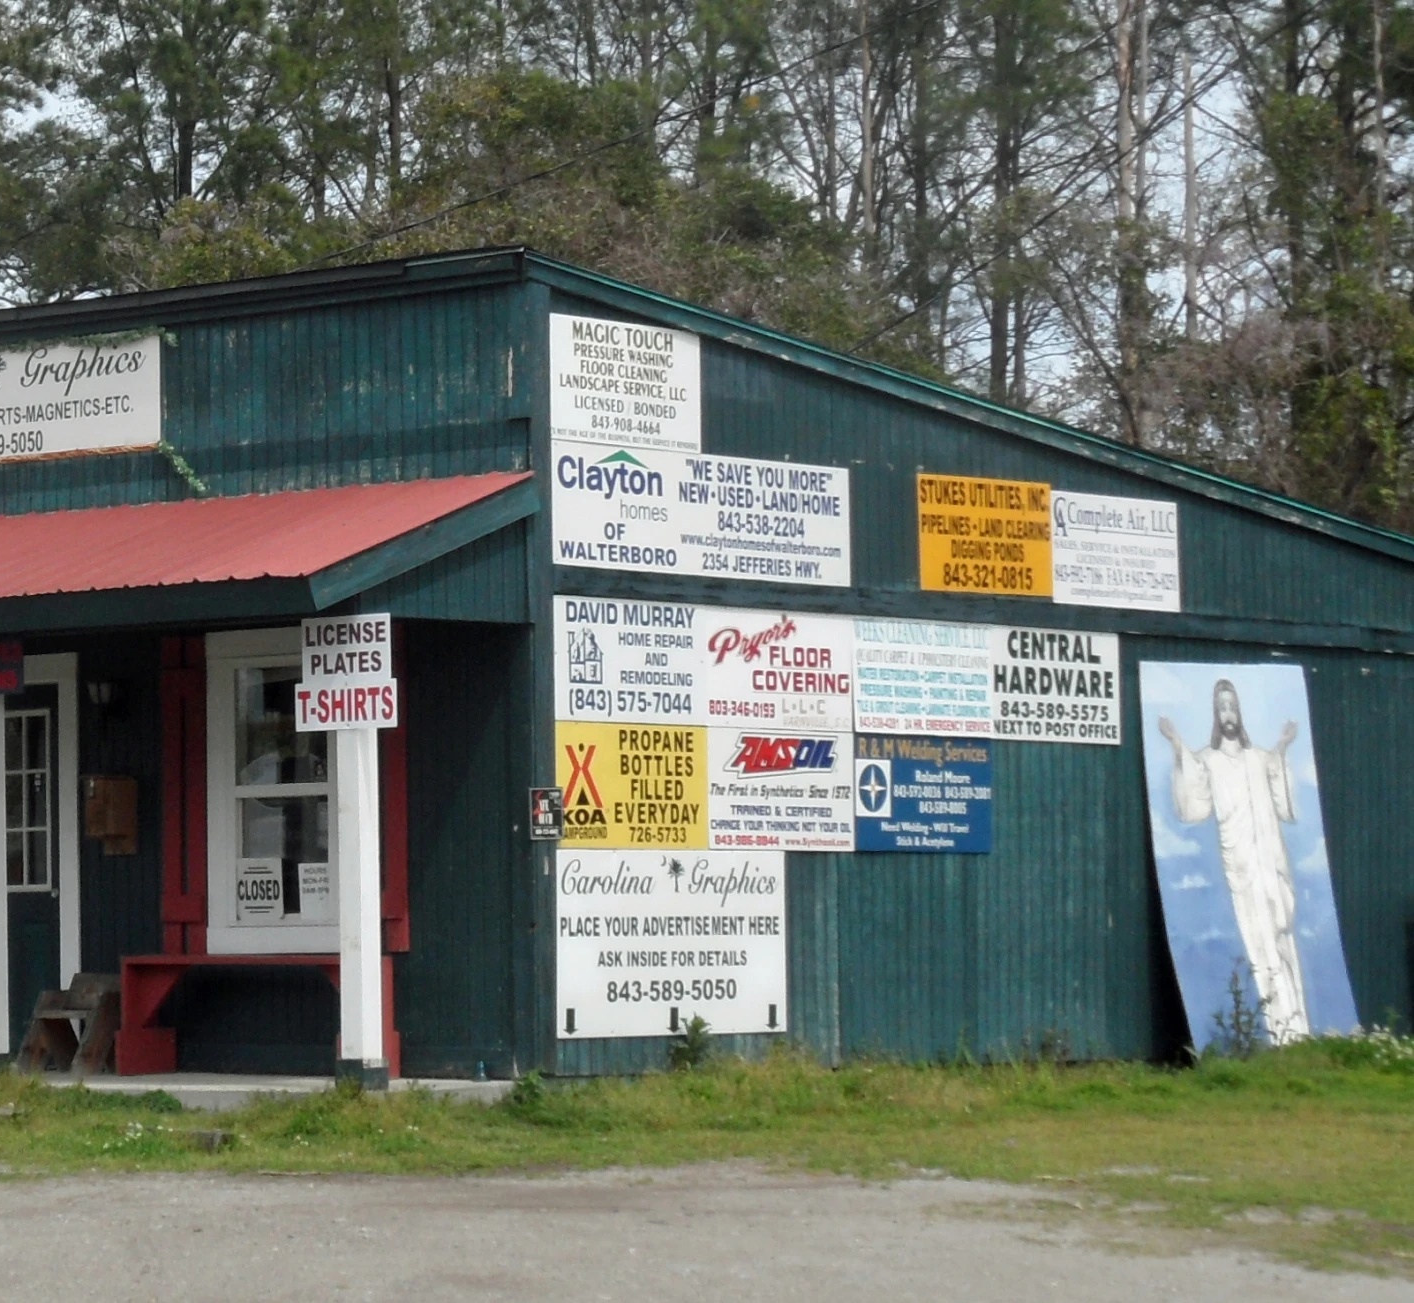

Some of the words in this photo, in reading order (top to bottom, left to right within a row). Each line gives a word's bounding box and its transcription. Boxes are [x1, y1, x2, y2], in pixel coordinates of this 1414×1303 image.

[572, 321, 620, 345] MAGIC
[625, 328, 673, 352] TOUCH
[574, 343, 625, 362] PRESSURE
[628, 349, 673, 368] WASHING
[20, 347, 146, 396] Graphics
[580, 360, 614, 376] FLOOR
[618, 365, 667, 383] CLEANING
[560, 374, 619, 394] LANDSCAPE
[623, 381, 666, 400] SERVICE,
[669, 386, 687, 401] LLC
[574, 395, 624, 413] LICENSED
[634, 402, 676, 419] BONDED
[592, 415, 660, 435] 843-908-4664
[557, 455, 663, 500] Clayton
[717, 462, 752, 486] SAVE
[756, 466, 784, 489] YOU
[920, 479, 966, 506] STUKES
[969, 483, 1025, 515] UTILITIES,
[1027, 487, 1049, 512] INC.
[619, 500, 668, 522] homes
[1068, 502, 1123, 533] Complete
[1127, 509, 1148, 532] Air,
[1151, 510, 1174, 533] LLC
[604, 522, 626, 540] OF
[717, 511, 805, 538] 843-538-2204
[921, 514, 970, 536] PIPELINES
[979, 518, 1003, 538] LAND
[1006, 520, 1050, 541] CLEARING
[559, 540, 677, 567] WALTERBORO
[680, 532, 841, 558] www.claytonhomesofwalterboro.com
[951, 539, 991, 560] DIGGING
[994, 542, 1024, 563] PONDS
[1081, 541, 1111, 553] SERVICE
[702, 552, 729, 572] 2354
[732, 555, 792, 578] JEFFERIES
[795, 559, 822, 579] HWY.
[943, 563, 1033, 590] 843-321-0815
[566, 601, 618, 625] DAVID
[623, 604, 695, 629] MURRAY
[306, 621, 386, 647] LICENSE
[618, 632, 651, 647] HOME
[654, 634, 693, 649] REPAIR
[708, 614, 796, 666] Pryor's
[886, 622, 932, 646] CLEANING
[934, 624, 971, 648] SERVICE
[769, 645, 832, 668] FLOOR
[1007, 630, 1101, 664] CENTRAL
[311, 651, 382, 675] PLATES
[645, 652, 668, 666] AND
[884, 650, 908, 664] CARPET
[958, 655, 988, 669] CLEANING
[620, 670, 693, 687] REMODELING
[752, 670, 850, 694] COVERING
[994, 664, 1114, 699] HARDWARE
[860, 683, 893, 697] PRESSURE
[894, 685, 923, 699] WASHING
[297, 686, 394, 724] T-SHIRTS
[569, 688, 612, 718] (843)
[617, 690, 692, 715] 575-7044
[709, 699, 775, 719] 803-346-0193
[1001, 700, 1109, 722] 843-589-5575
[926, 719, 963, 731] EMERGENCY
[965, 721, 990, 732] SERVICE
[994, 720, 1023, 735] NEXT
[1026, 721, 1041, 735] TO
[1045, 722, 1075, 737] POST
[1079, 723, 1117, 739] OFFICE
[619, 730, 694, 752] PROPANE
[858, 737, 867, 757] R
[871, 738, 880, 758] &
[884, 739, 894, 758] M
[897, 739, 943, 767] Welding
[945, 741, 988, 762] Services
[620, 754, 694, 777] BOTTLES
[730, 736, 835, 774] AMSOIL
[915, 770, 942, 783] Roland
[945, 771, 971, 784] Moore
[631, 779, 684, 800] FILLED
[710, 783, 726, 796] The
[728, 784, 749, 797] First
[750, 785, 758, 797] in
[760, 784, 804, 800] Synthetics
[808, 785, 828, 799] Since
[563, 809, 607, 825] KOA
[614, 802, 700, 825] EVERYDAY
[730, 805, 771, 816] TRAINED
[775, 806, 781, 816] &
[786, 806, 832, 818] CERTIFIED
[629, 827, 687, 843] 726-5733
[710, 819, 741, 830] CHANGE
[744, 820, 764, 830] YOUR
[766, 821, 799, 832] THINKING
[802, 822, 816, 832] NOT
[819, 822, 839, 832] YOUR
[840, 823, 851, 833] OIL
[881, 821, 900, 832] Need
[902, 822, 929, 835] Welding
[933, 822, 948, 832] Will
[949, 823, 969, 833] Travel
[896, 836, 912, 846] Stick
[922, 837, 954, 849] Acetylene
[237, 880, 280, 900] CLOSED
[561, 859, 654, 895] Carolina
[688, 859, 776, 908] Graphics
[560, 916, 600, 937] PLACE
[605, 916, 638, 937] YOUR
[642, 916, 745, 936] ADVERTISEMENT
[749, 916, 779, 935] HERE
[597, 951, 623, 967] ASK
[627, 951, 667, 967] INSIDE
[671, 951, 695, 966] FOR
[699, 950, 747, 966] DETAILS
[607, 979, 737, 1003] 843-589-5050
